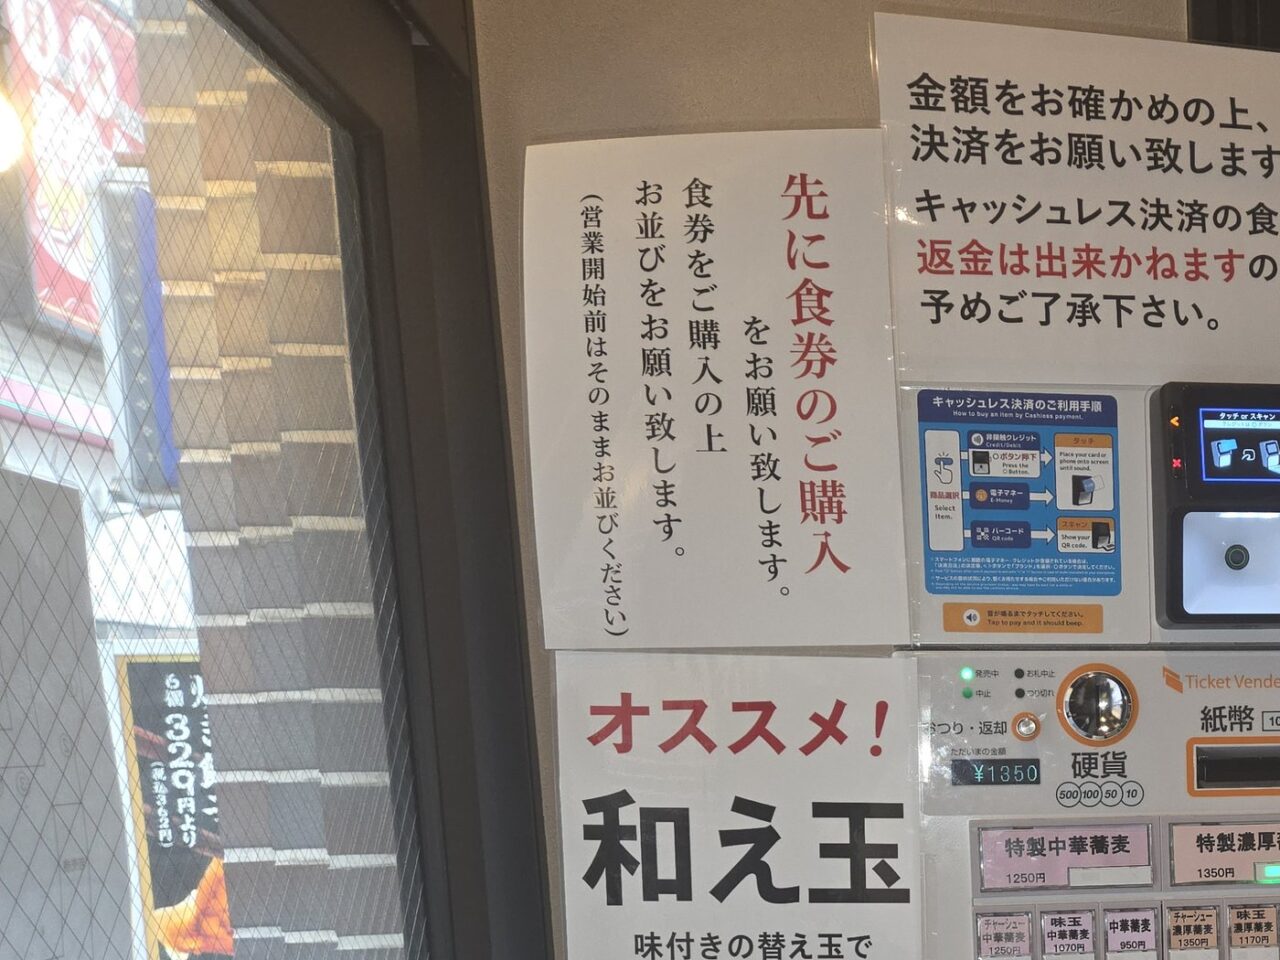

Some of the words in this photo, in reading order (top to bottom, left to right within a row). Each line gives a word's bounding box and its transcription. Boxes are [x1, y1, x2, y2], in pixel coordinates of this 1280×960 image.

[906, 70, 1271, 134] 金額をお確かめの上、
[682, 177, 728, 456] 食券をご購入の上
[920, 289, 1223, 332] 予めご了承下さい。
[633, 179, 687, 559] お並びをお願い致します。
[780, 173, 852, 576] 先に食券のご購入
[933, 396, 1102, 412] キャッシュレス決済のご利用手順
[1219, 412, 1239, 420] タッチ
[1250, 412, 1276, 420] スキャン
[742, 316, 790, 598] をお願い致します。
[992, 527, 1024, 535] バーコード
[1185, 675, 1231, 689] Ticket
[976, 690, 991, 698] 中止
[587, 692, 889, 757] オススメ!
[1200, 705, 1254, 733] 紙幣
[1071, 751, 1127, 779] 硬貨
[973, 764, 1038, 782] ¥1350
[1059, 790, 1078, 799] 500
[1082, 790, 1099, 799] 100
[1104, 789, 1117, 798] 50
[1127, 789, 1137, 798] 10
[582, 788, 911, 906] 和え玉
[1005, 834, 1130, 858] 特製中華蕎麦
[1006, 873, 1046, 884] 1250円
[1197, 868, 1235, 878] 1350円
[1174, 911, 1213, 923] チャーシュー
[1236, 910, 1266, 920] 味玉
[1050, 917, 1082, 927] 味玉
[1109, 919, 1151, 934] 中華蕎麦
[1233, 922, 1274, 933] 濃厚蕎麦
[1047, 929, 1090, 941] 中華蕎麦
[1172, 924, 1213, 936] 濃厚蕎麦
[633, 931, 873, 960] 味付きの替え玉で
[1120, 941, 1146, 949] 950円
[1178, 938, 1209, 947] 1350円
[1239, 936, 1269, 944] 1170円
[1053, 944, 1085, 952] 1070円
